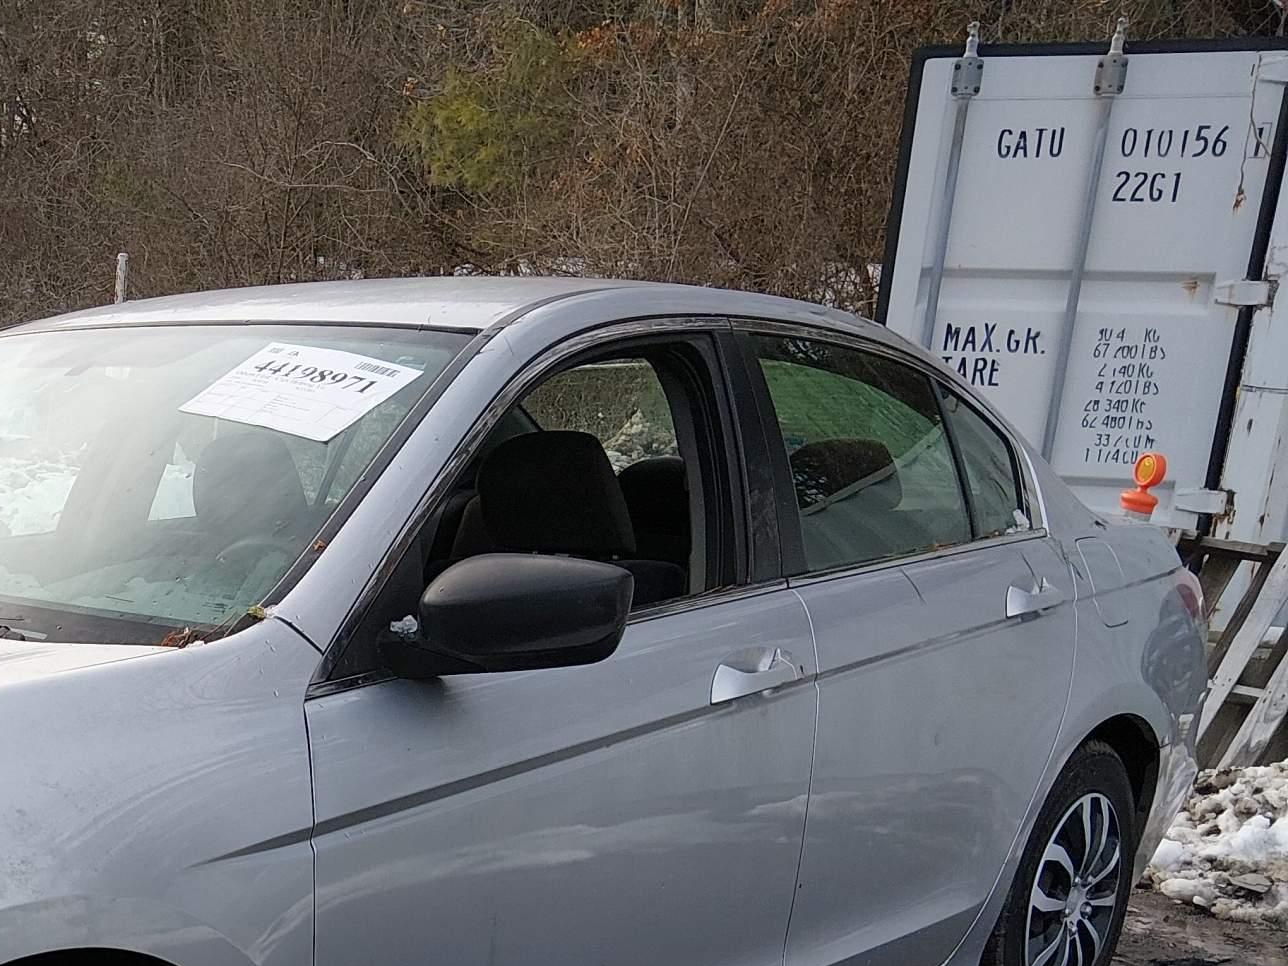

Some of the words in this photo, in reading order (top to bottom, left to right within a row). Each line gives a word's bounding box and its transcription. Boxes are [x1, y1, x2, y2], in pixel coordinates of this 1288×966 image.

[997, 127, 1065, 158] GATU
[1121, 125, 1230, 158] 010156
[1112, 171, 1182, 202] 22G1
[254, 360, 379, 393] 44198971
